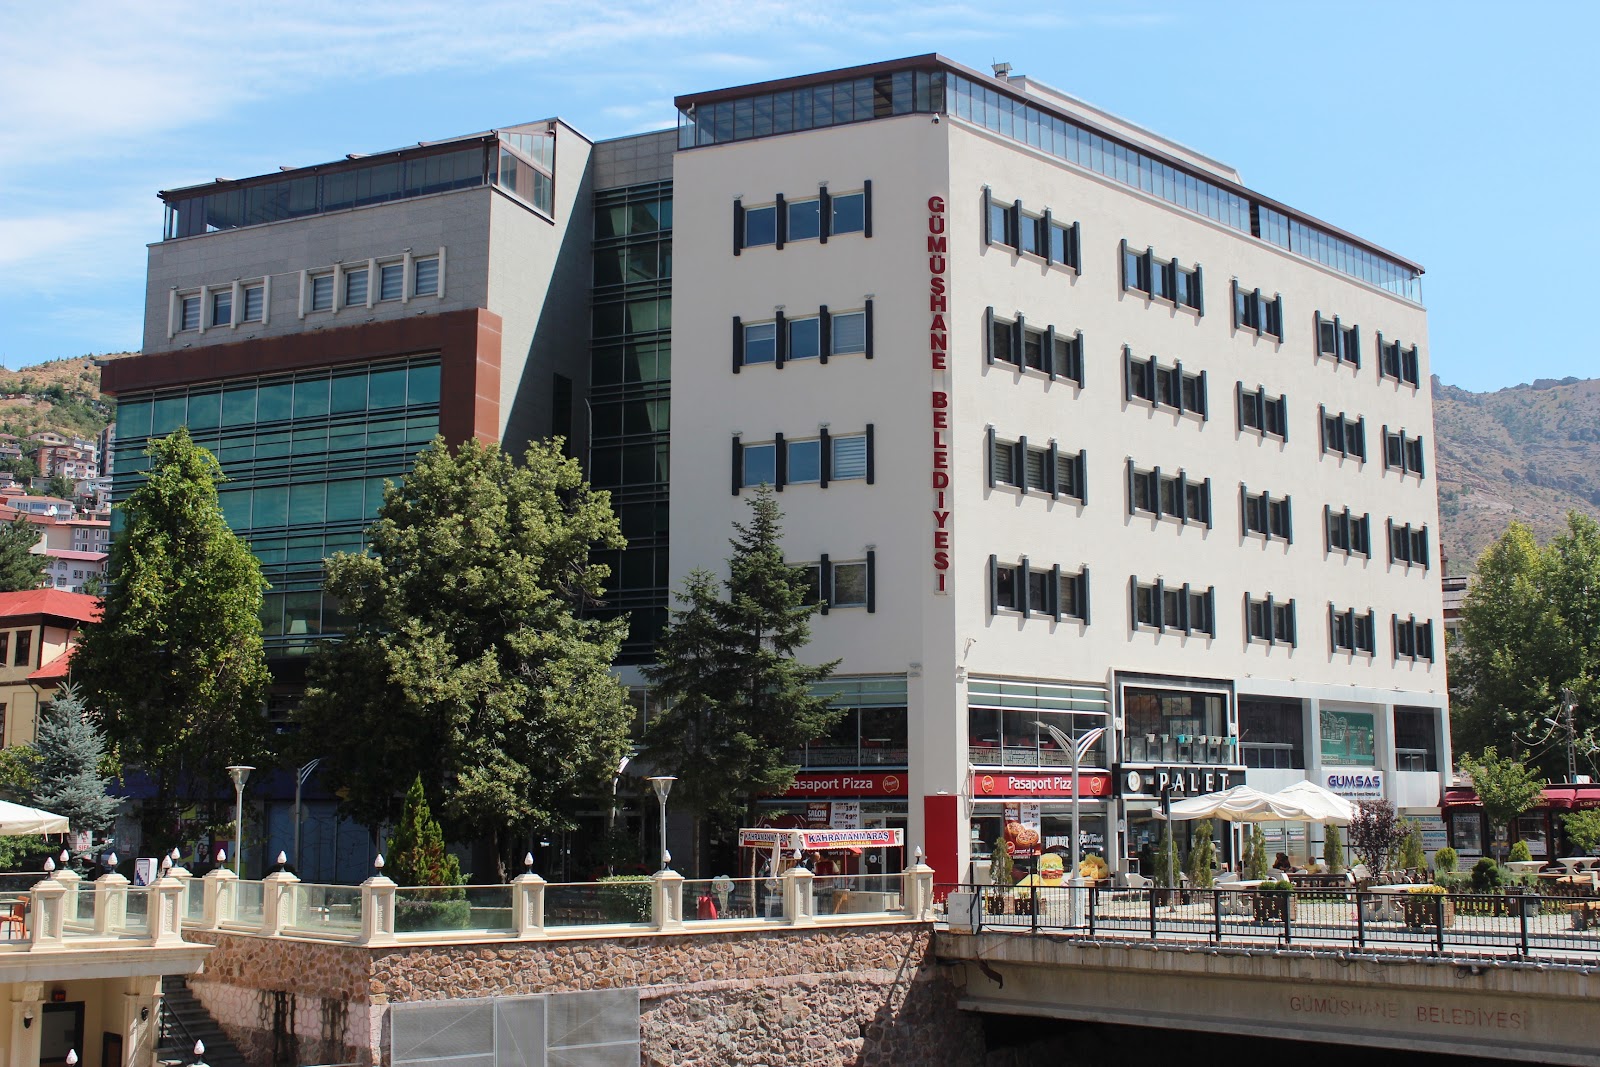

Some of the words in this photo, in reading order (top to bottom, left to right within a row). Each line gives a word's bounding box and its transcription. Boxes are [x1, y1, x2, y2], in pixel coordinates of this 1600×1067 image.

[928, 196, 947, 370] GÜMÜŞHANE
[842, 777, 873, 790] Pizza
[1008, 776, 1052, 793] Pasaport
[1053, 776, 1072, 790] Pizz
[1159, 772, 1229, 792] PALET
[807, 809, 827, 818] SALON
[808, 831, 889, 843] KAHRAMANMARAŞ
[1417, 1006, 1527, 1030] BELEDİYESİ
